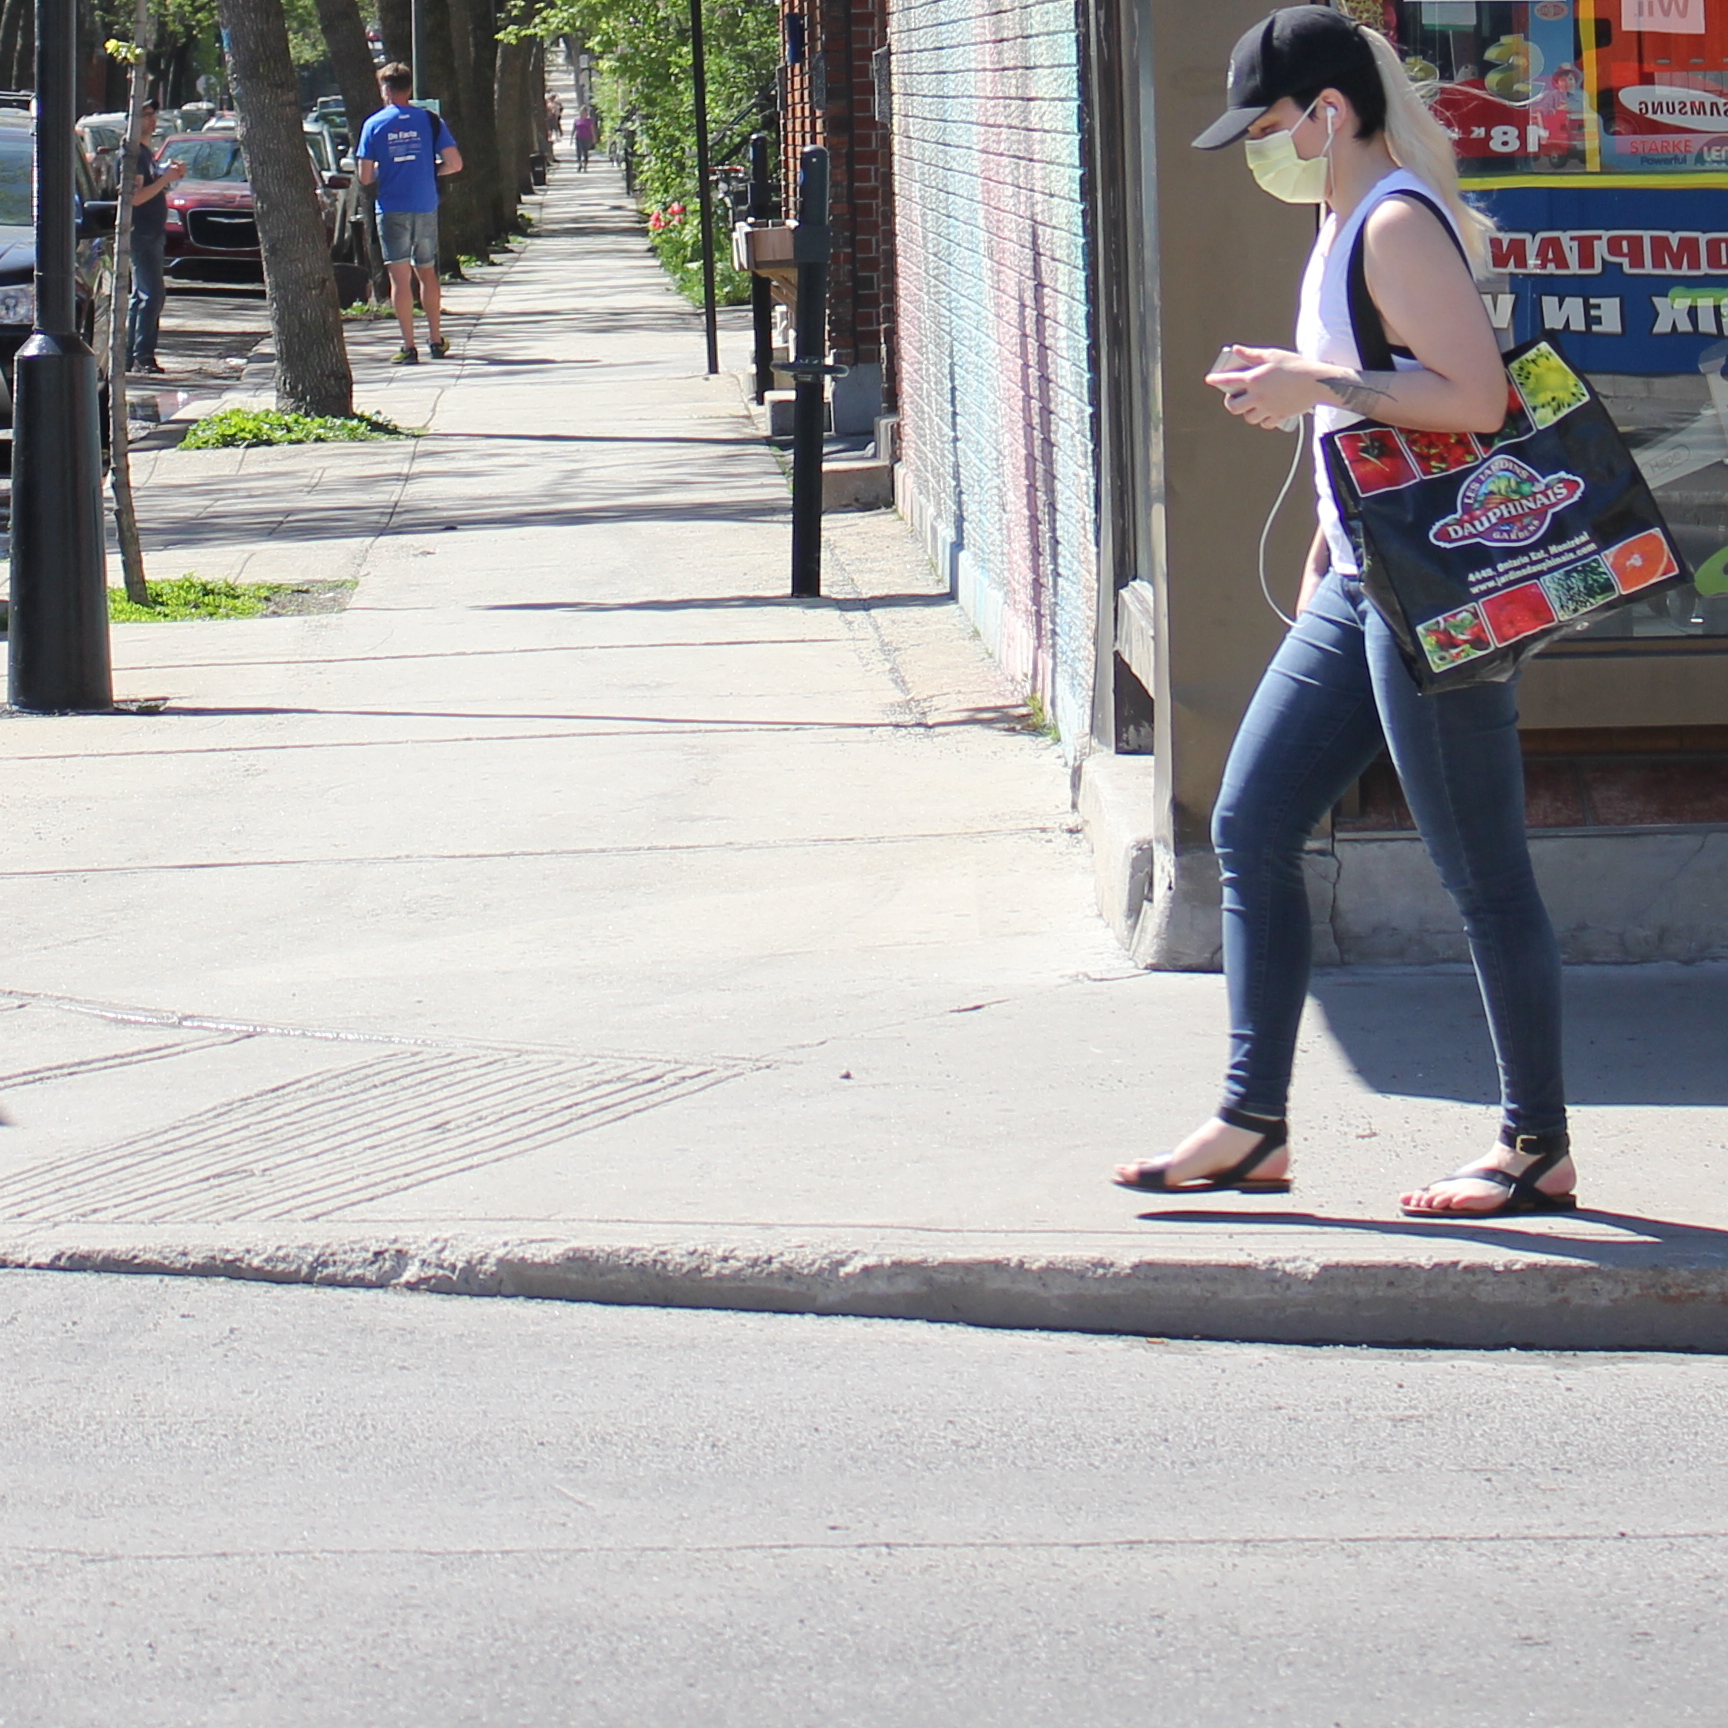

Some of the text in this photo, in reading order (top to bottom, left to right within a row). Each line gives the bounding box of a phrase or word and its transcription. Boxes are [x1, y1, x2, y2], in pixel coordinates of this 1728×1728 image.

[1629, 138, 1693, 153] STARKE
[1640, 154, 1687, 165] Powerful
[1478, 459, 1530, 481] JARDINS
[1447, 483, 1569, 539] DAUPHINAIS
[1496, 554, 1531, 573] Ontario
[1548, 531, 1590, 555] Montréal
